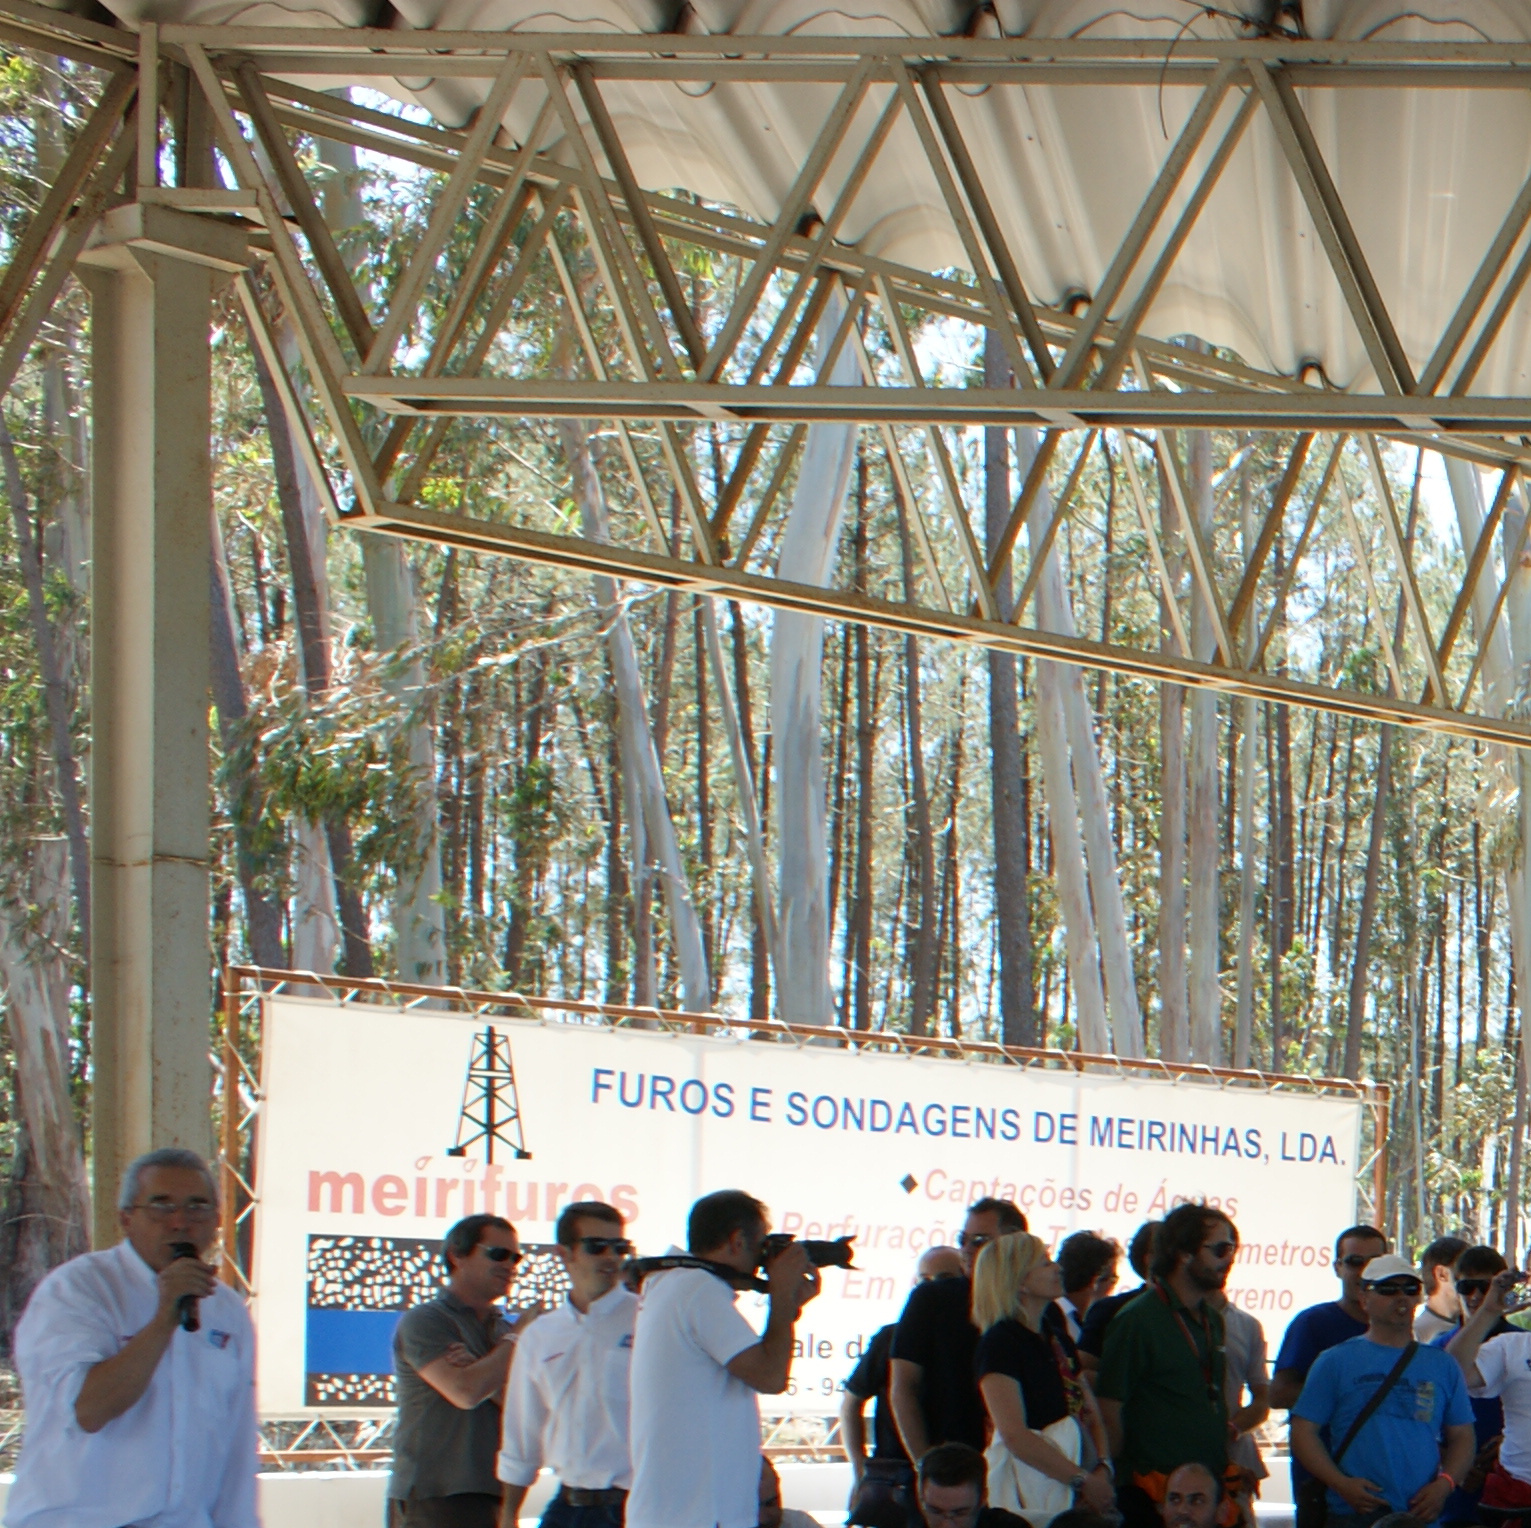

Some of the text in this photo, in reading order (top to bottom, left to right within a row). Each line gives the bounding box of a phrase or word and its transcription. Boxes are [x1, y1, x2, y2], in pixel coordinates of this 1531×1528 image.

[591, 1067, 1348, 1167] FUROS E SONDAGENS DE MEIRINHAS, LDA.
[924, 1168, 1093, 1213] Captações
[1103, 1183, 1139, 1214] de
[841, 1269, 896, 1301] Em
[789, 1333, 839, 1362] ale
